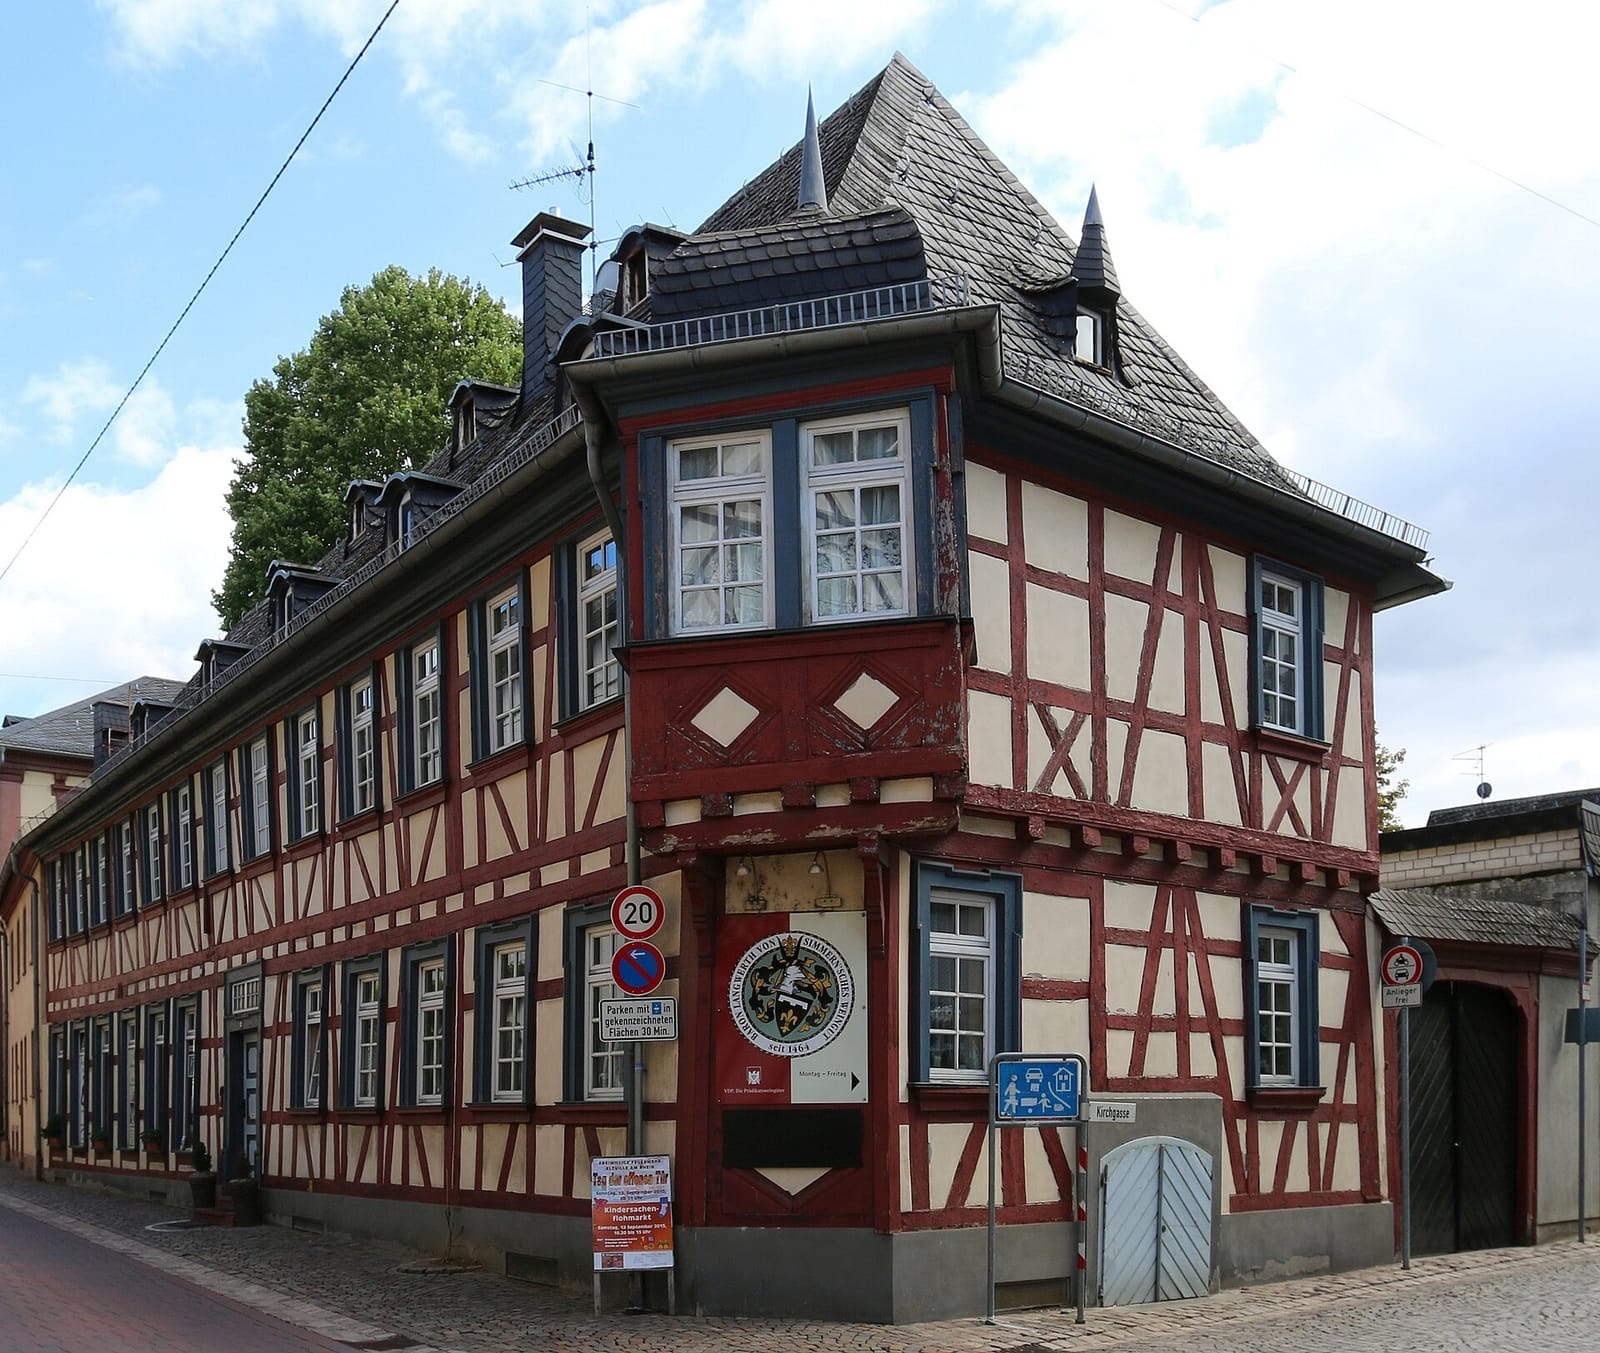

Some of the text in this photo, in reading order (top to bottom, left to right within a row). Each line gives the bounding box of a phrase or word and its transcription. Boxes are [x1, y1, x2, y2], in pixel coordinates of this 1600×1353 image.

[624, 902, 652, 924] 20
[758, 938, 776, 953] VON
[732, 952, 757, 1009] LANGWERTH
[607, 1003, 671, 1015] Parken mit in
[605, 1016, 673, 1028] gekennzeichneten
[735, 1011, 758, 1040] BARON
[823, 1002, 849, 1041] WEINGUT
[609, 1026, 670, 1037] Flächen 30 Min.
[768, 1044, 810, 1053] seit 1464
[1096, 1105, 1130, 1121] Kirchgasse
